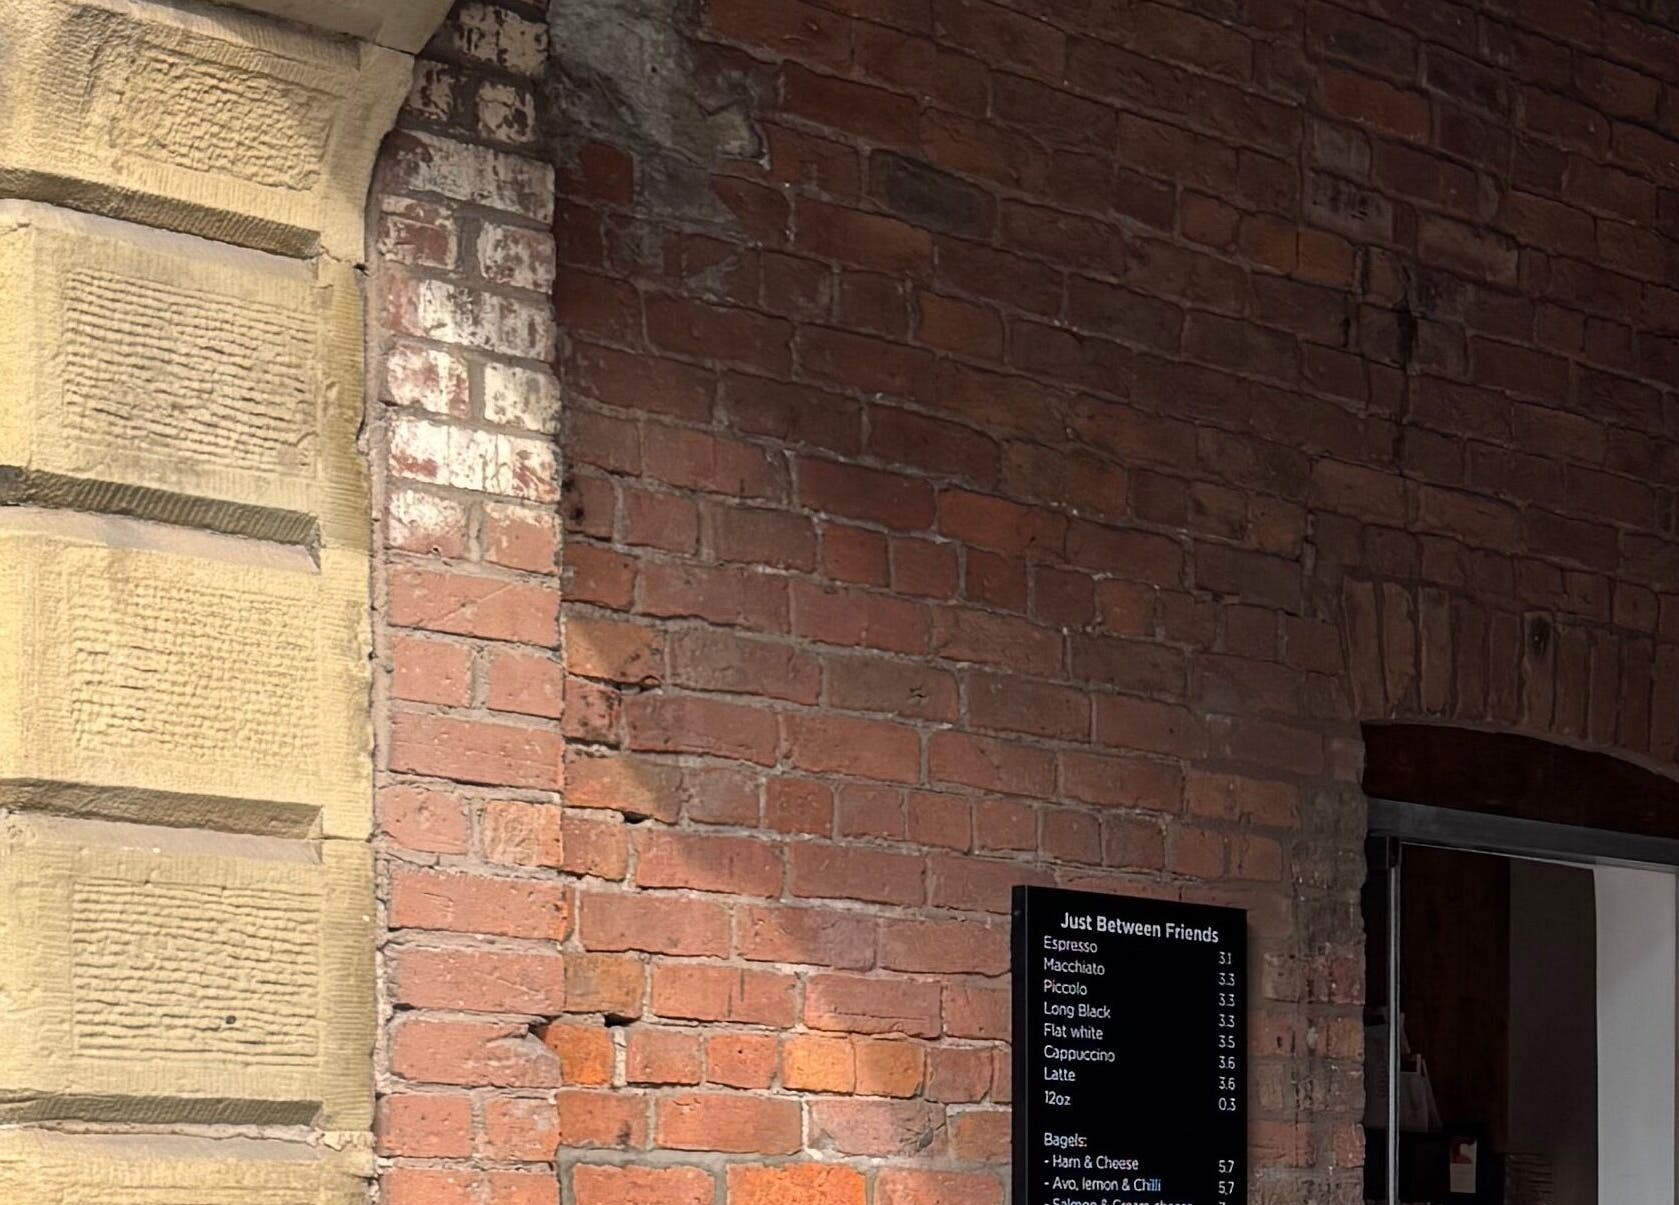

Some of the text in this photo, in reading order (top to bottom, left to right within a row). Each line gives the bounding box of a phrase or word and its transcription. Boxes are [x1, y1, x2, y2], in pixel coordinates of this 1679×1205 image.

[1060, 911, 1219, 944] Just Between Friends
[1043, 934, 1098, 954] Espresso
[1043, 956, 1106, 976] Macchiato
[1043, 978, 1088, 996] Piccolo
[1043, 1001, 1076, 1019] Long
[1077, 1003, 1111, 1019] Black
[1043, 1022, 1068, 1038] Flat
[1070, 1025, 1104, 1041] white
[1043, 1044, 1236, 1070] Cappuccino 3.6
[1043, 1066, 1236, 1091] Latte 3.6
[1044, 1090, 1071, 1106] 12oz
[1052, 1153, 1082, 1169] Ham
[1083, 1154, 1093, 1169] &
[1095, 1155, 1139, 1171] Cheese
[1081, 1176, 1119, 1192] lemon
[1121, 1177, 1131, 1192] &
[1133, 1178, 1161, 1192] Chilli
